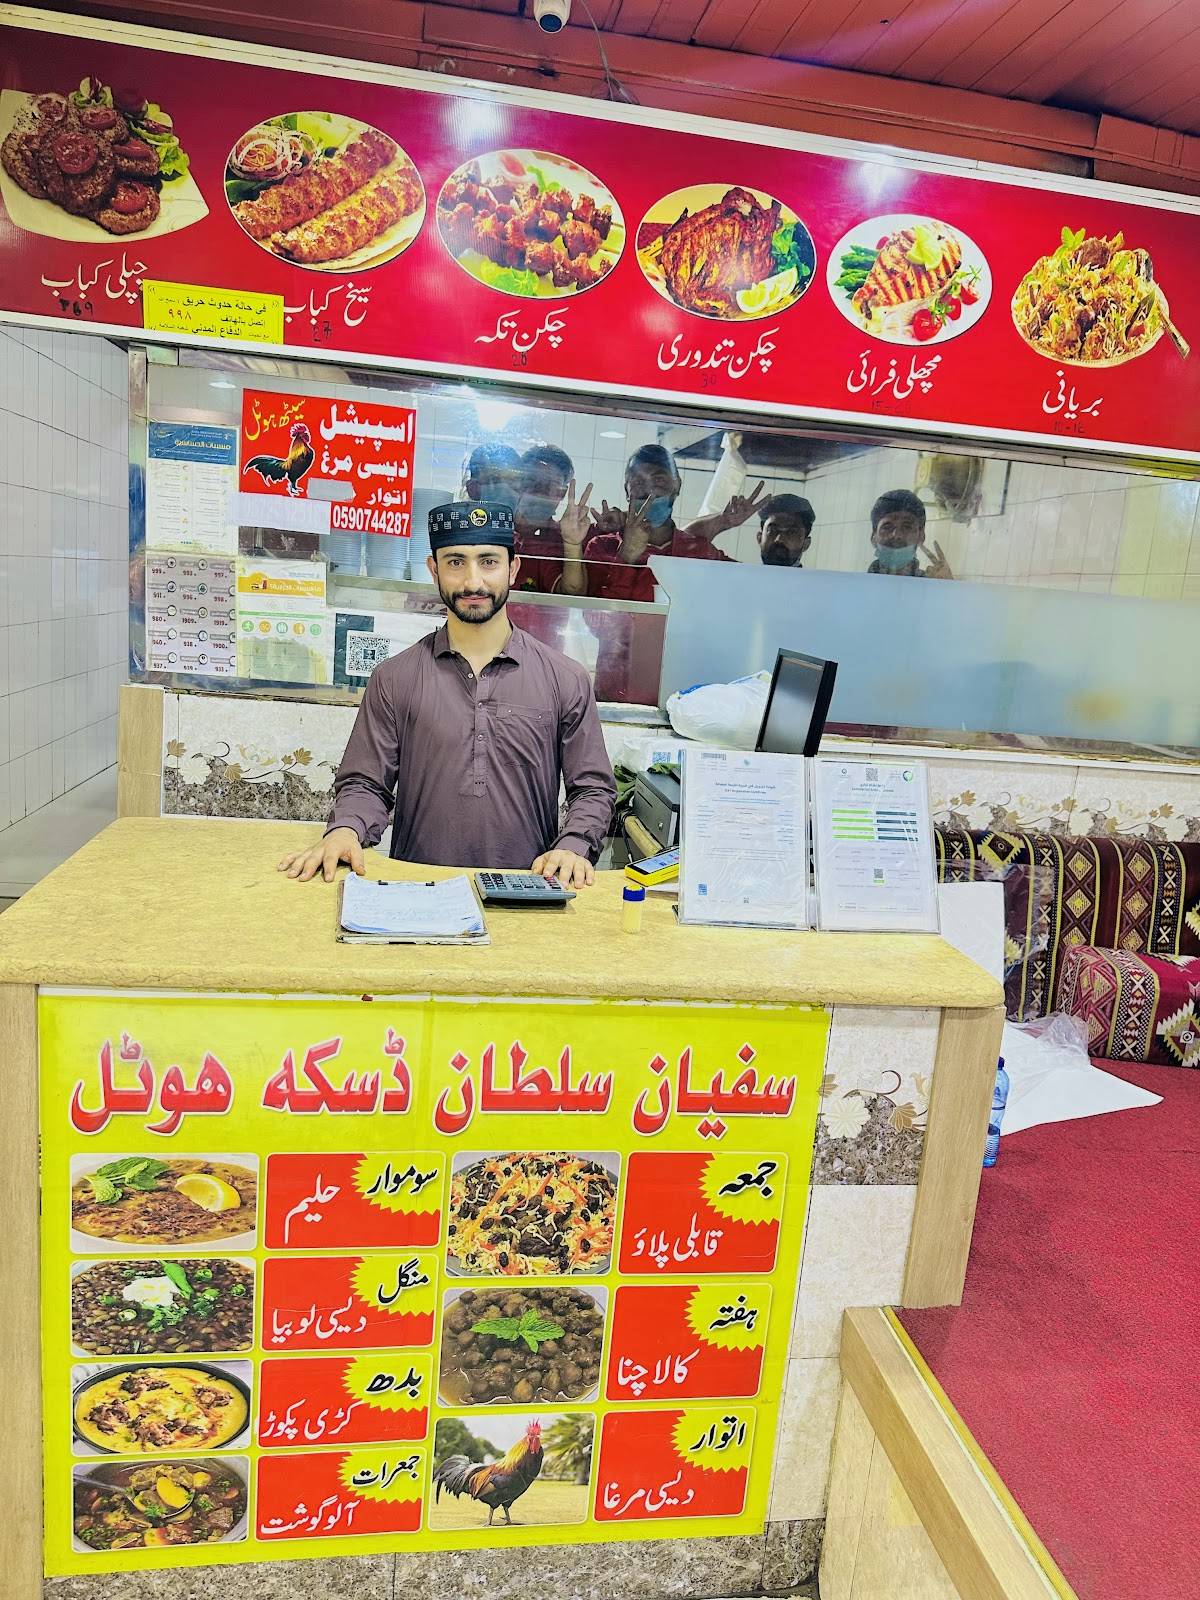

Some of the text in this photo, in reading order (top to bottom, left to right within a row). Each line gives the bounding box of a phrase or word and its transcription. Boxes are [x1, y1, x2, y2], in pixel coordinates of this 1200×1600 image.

[41, 259, 114, 299] کباب
[343, 281, 373, 327] سیخ
[473, 307, 570, 352] چکن تکہ
[657, 327, 780, 379] چکن تندوری
[892, 354, 943, 399] مچھلی
[1041, 369, 1104, 420] بریانی
[319, 403, 414, 452] اسپیشل
[320, 444, 354, 476] مرغ
[366, 487, 407, 507] اتوار
[332, 504, 410, 536] 0590744287
[433, 1040, 615, 1137] سلطان
[366, 1162, 438, 1195] سوموار
[284, 1173, 341, 1245] حلیم
[673, 1212, 724, 1262] قابلی
[377, 1257, 430, 1304] منگل
[271, 1304, 317, 1343] لوبیا
[709, 1295, 758, 1330] ہفتہ
[365, 1367, 422, 1398] بدھ
[617, 1348, 700, 1397] کالا چنا
[304, 1400, 364, 1440] کڑی
[689, 1415, 746, 1451] اتوار
[352, 1455, 420, 1489] جمعرات
[603, 1481, 646, 1516] مرغا
